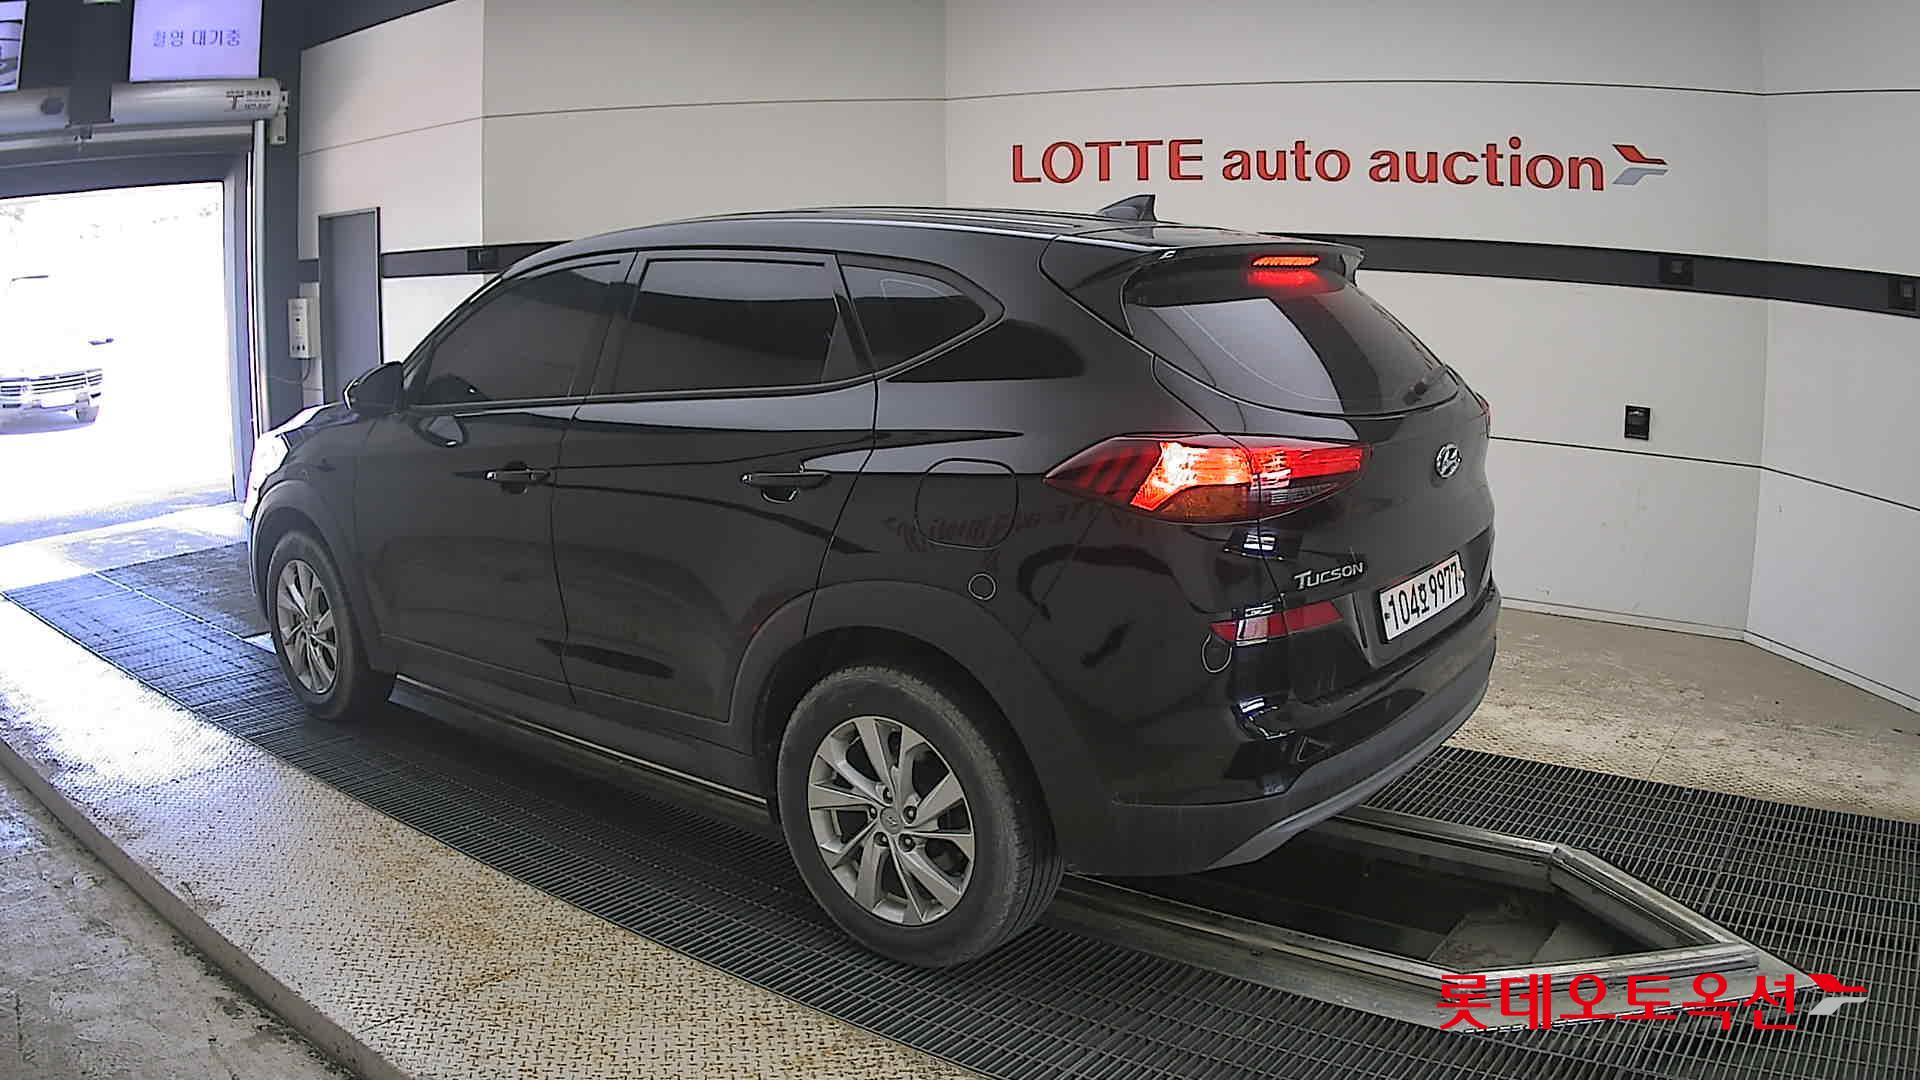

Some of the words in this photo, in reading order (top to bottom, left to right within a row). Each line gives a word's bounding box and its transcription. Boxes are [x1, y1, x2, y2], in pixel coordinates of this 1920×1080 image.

[192, 29, 240, 47] 대기중
[1012, 139, 1204, 184] LOTTE
[1222, 140, 1351, 183] auto
[1368, 136, 1604, 191] auction
[1294, 561, 1365, 591] TUCSON
